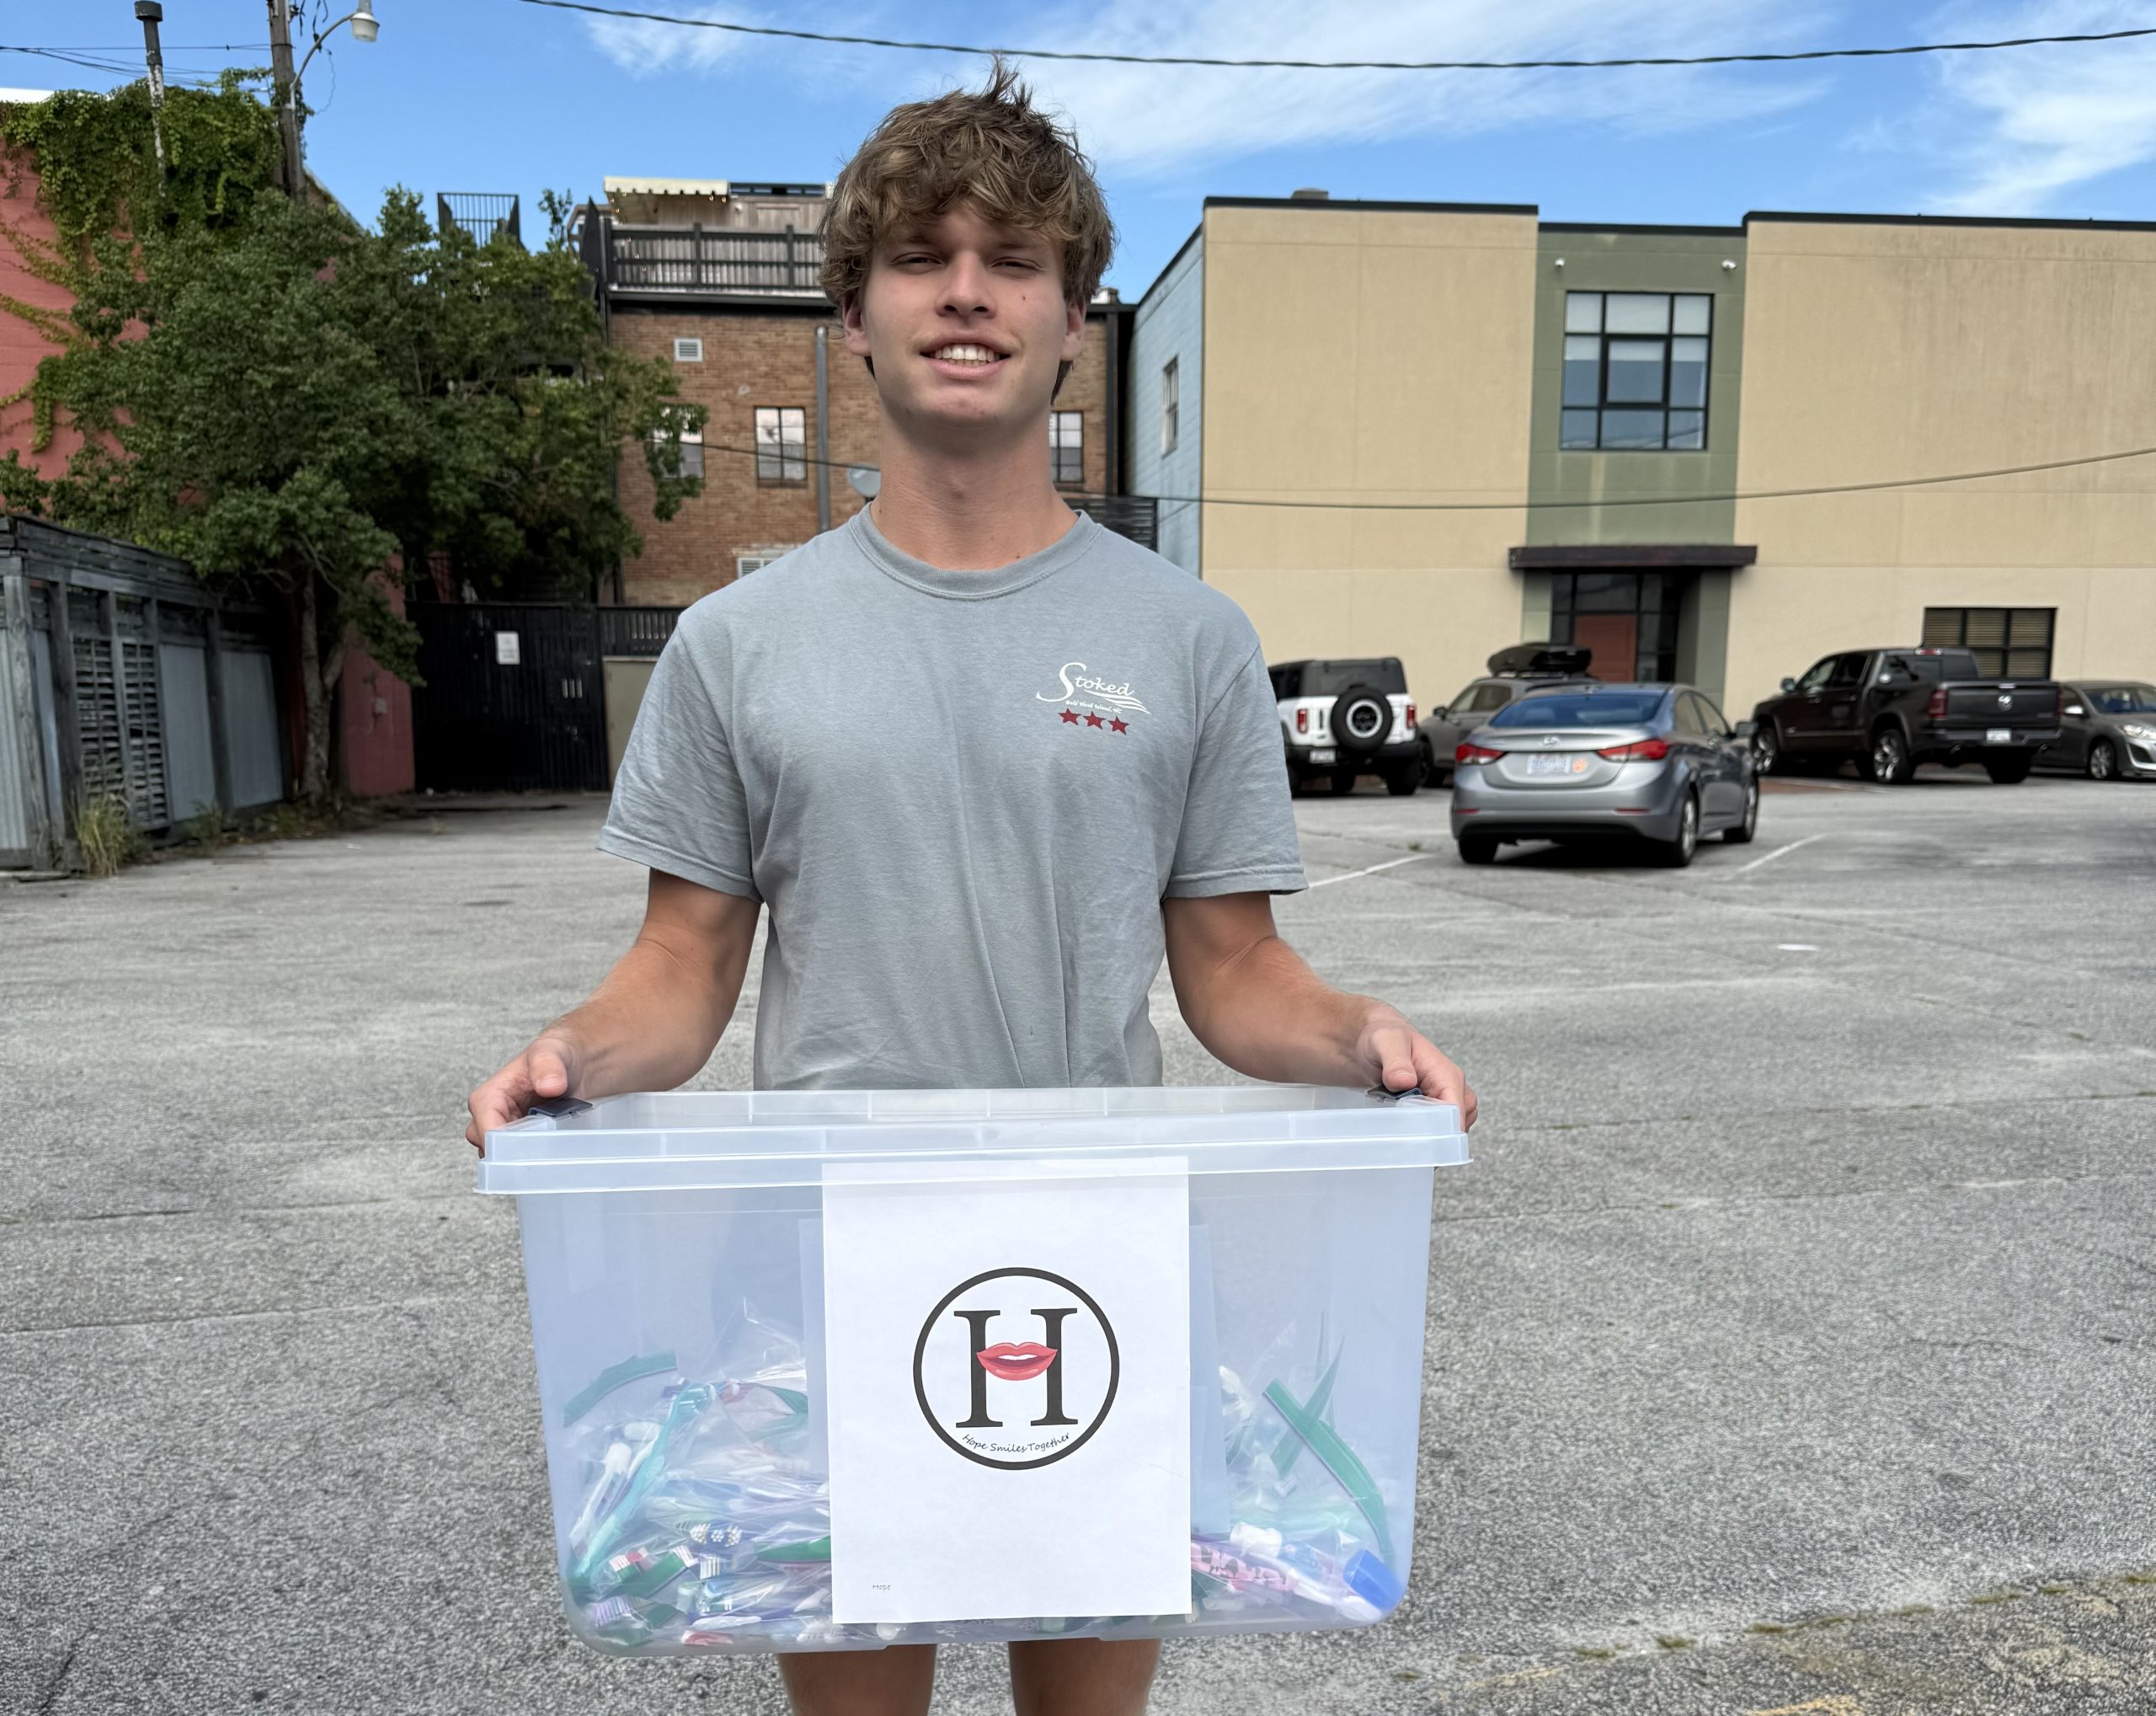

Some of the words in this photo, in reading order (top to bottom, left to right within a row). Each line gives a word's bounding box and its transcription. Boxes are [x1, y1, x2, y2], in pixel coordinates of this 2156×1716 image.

[1036, 662, 1134, 702] Stoked
[962, 1434, 988, 1450] Hope
[990, 1443, 1027, 1453] Smiles
[1027, 1432, 1070, 1451] Together
